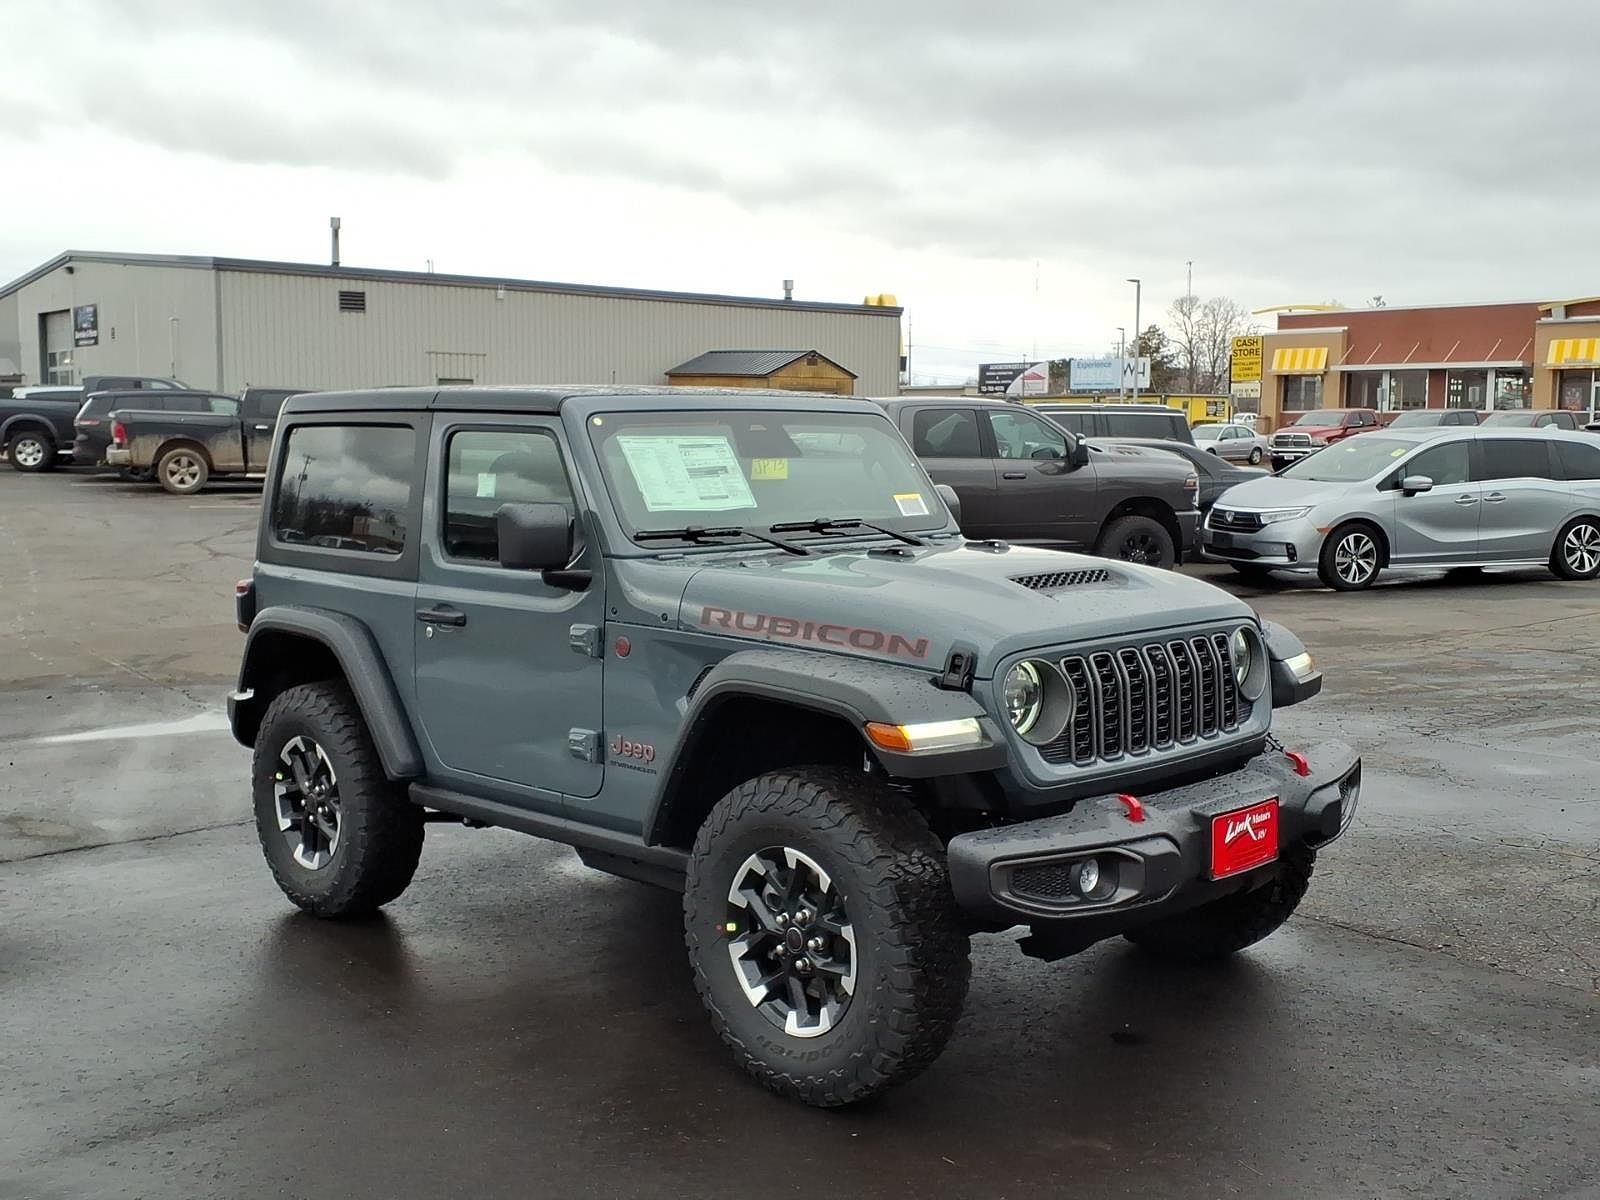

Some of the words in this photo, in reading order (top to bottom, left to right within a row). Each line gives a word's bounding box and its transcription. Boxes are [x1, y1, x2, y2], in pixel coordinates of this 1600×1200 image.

[1232, 348, 1260, 357] STORE
[1236, 338, 1259, 348] CASH
[1076, 360, 1112, 370] Experience
[701, 606, 929, 658] RUBICON
[609, 734, 655, 764] Jeep
[1224, 813, 1257, 844] Link
